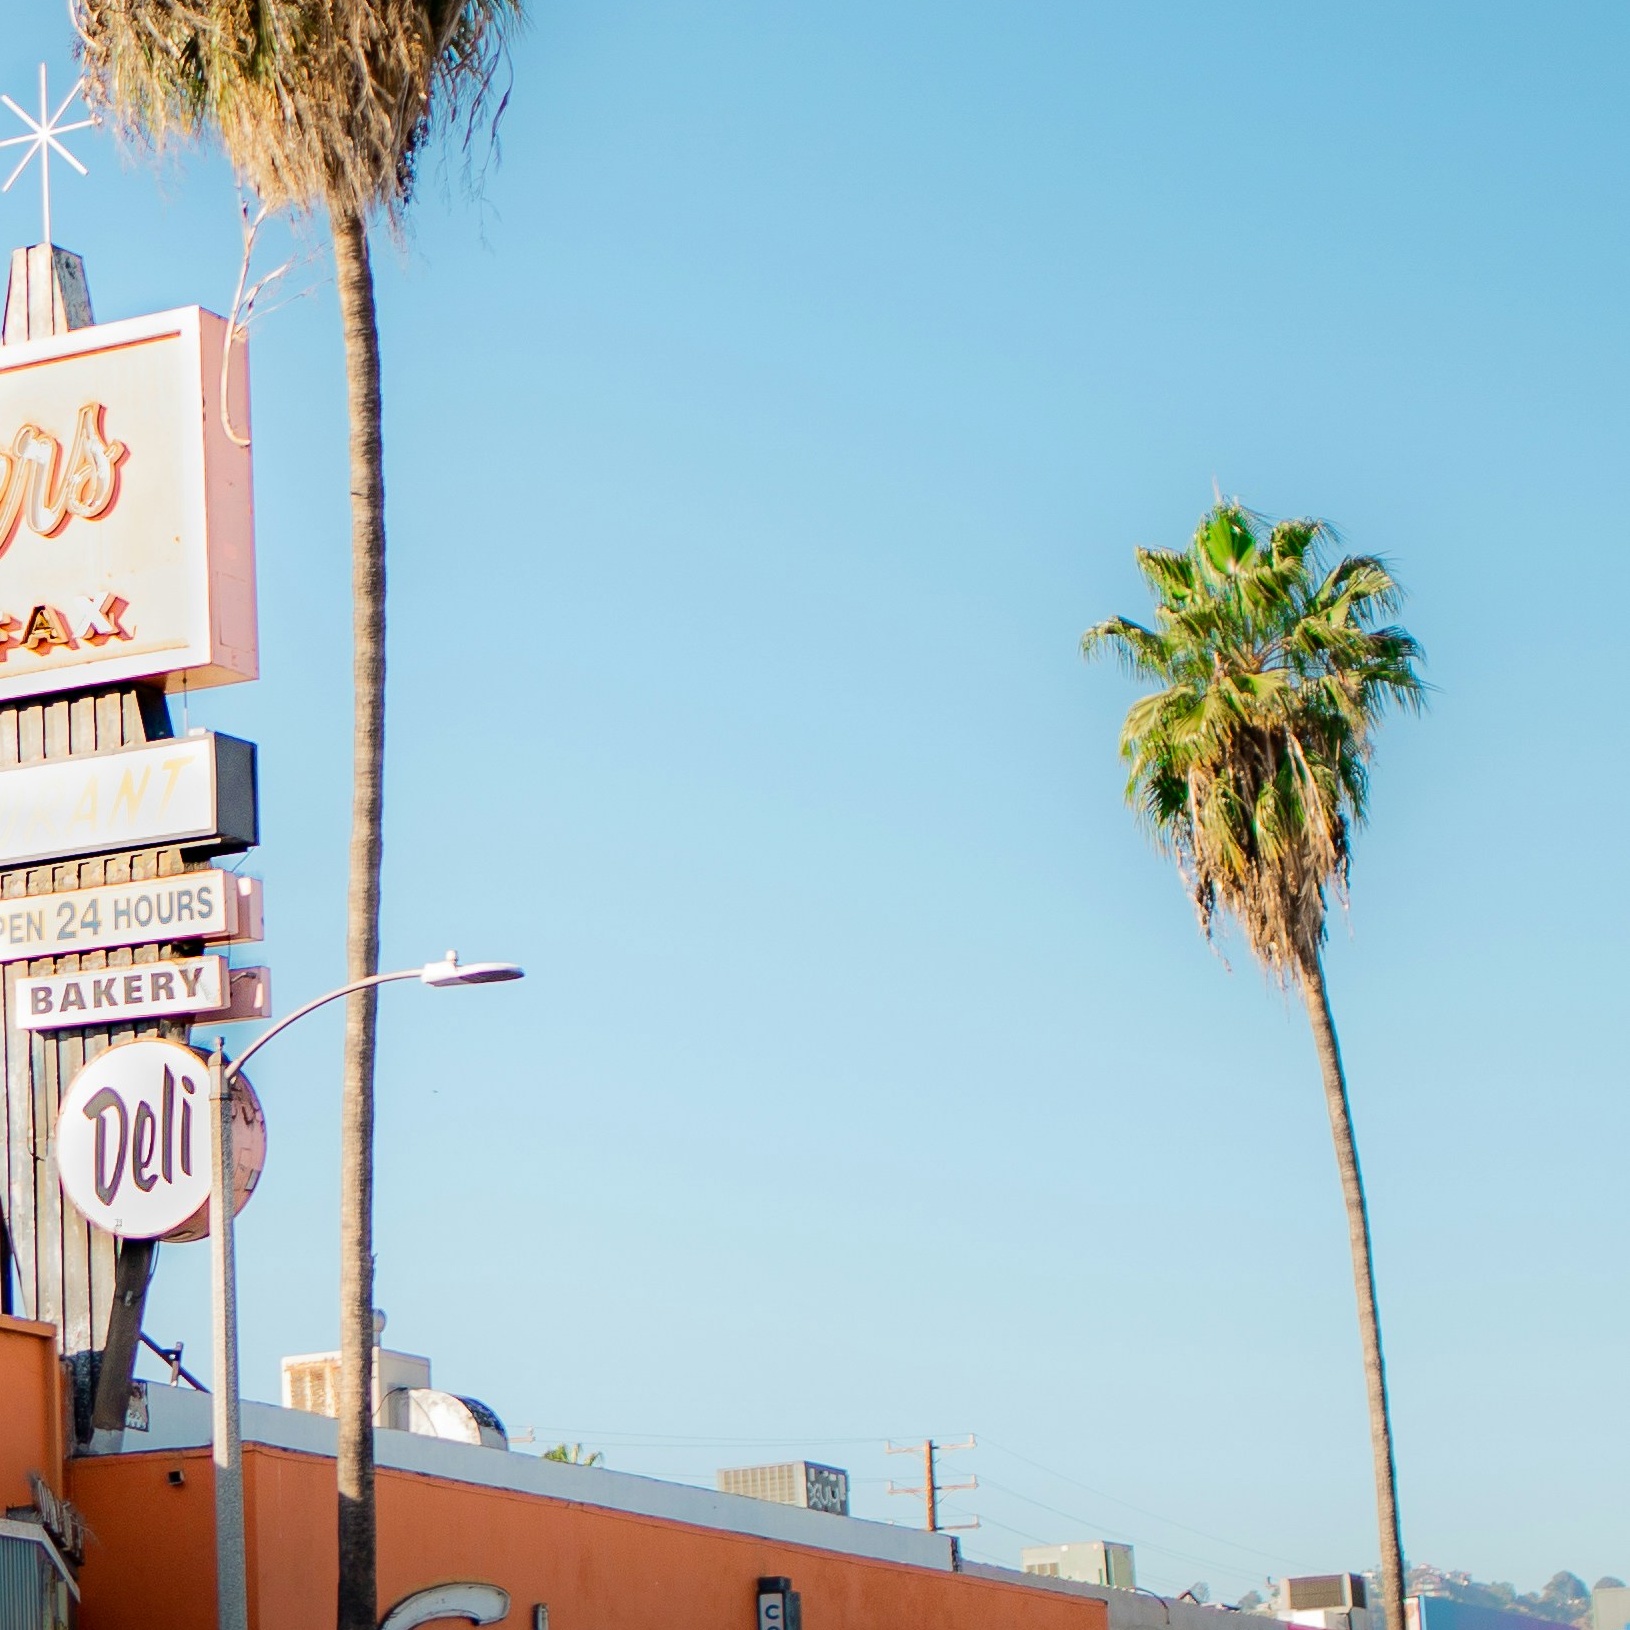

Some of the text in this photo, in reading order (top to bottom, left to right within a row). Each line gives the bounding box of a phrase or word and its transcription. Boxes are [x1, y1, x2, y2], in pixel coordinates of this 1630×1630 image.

[56, 898, 103, 942] 24
[114, 885, 214, 930] HOURS
[30, 966, 205, 1016] BAKERY
[82, 1063, 196, 1207] Deli
